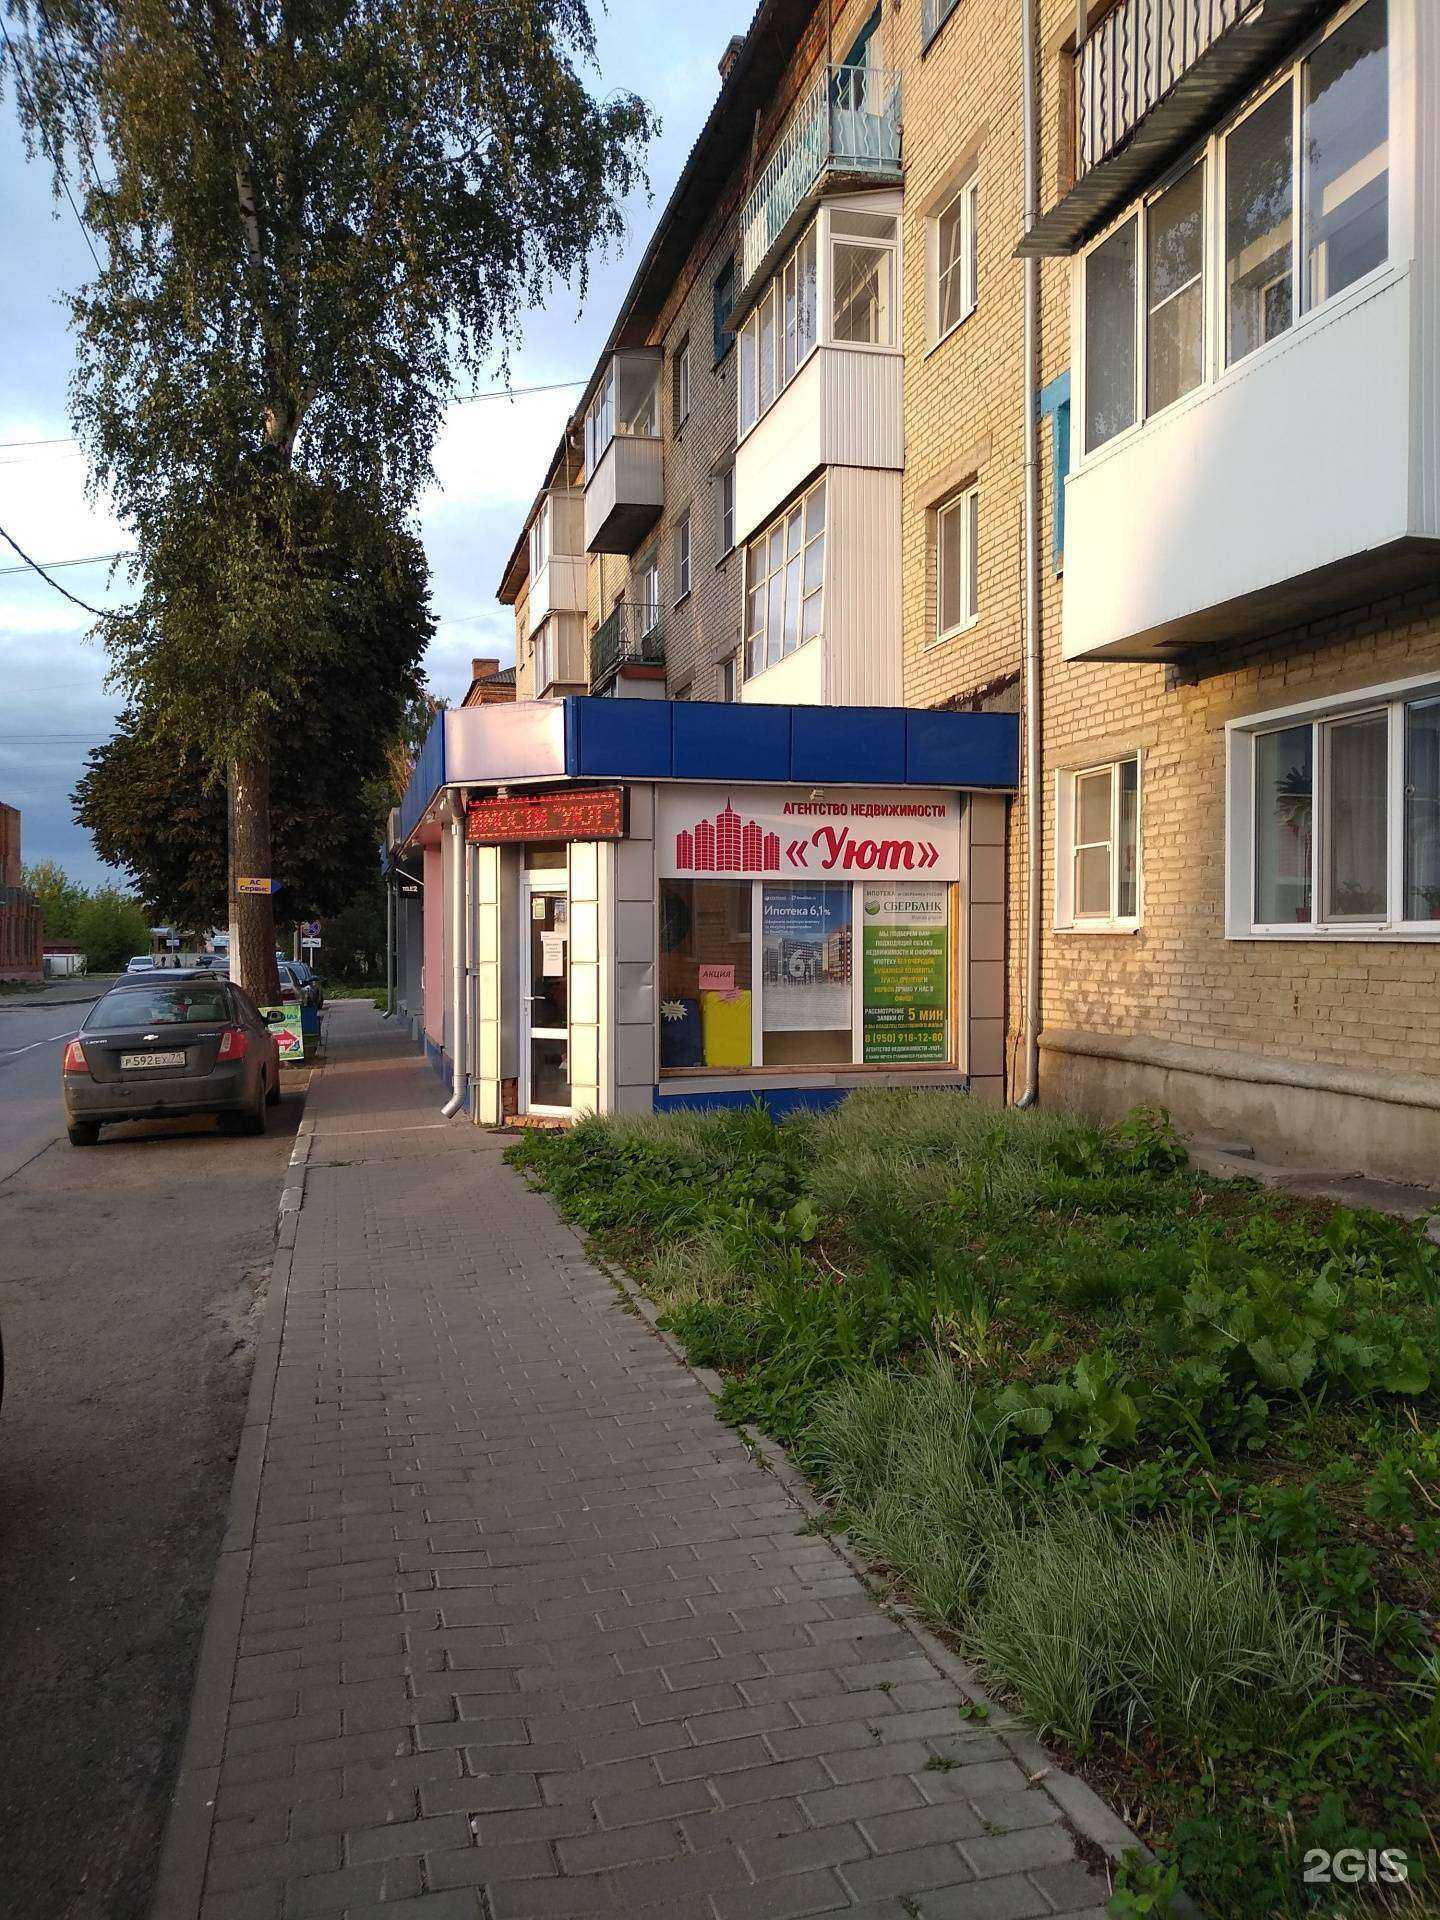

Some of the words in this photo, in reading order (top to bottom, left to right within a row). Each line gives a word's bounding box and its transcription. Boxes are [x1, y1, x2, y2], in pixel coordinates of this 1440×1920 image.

[783, 802, 848, 815] АГЕНТСТВО
[850, 803, 946, 818] НЕДВИЖИМОСТИ
[785, 826, 940, 870] «Уют»
[764, 905, 808, 916] Ипотека
[884, 902, 942, 912] СБЕРБАНК
[703, 970, 731, 978] АКЦИЯ
[908, 1008, 915, 1021] 5
[920, 1010, 944, 1021] МИН
